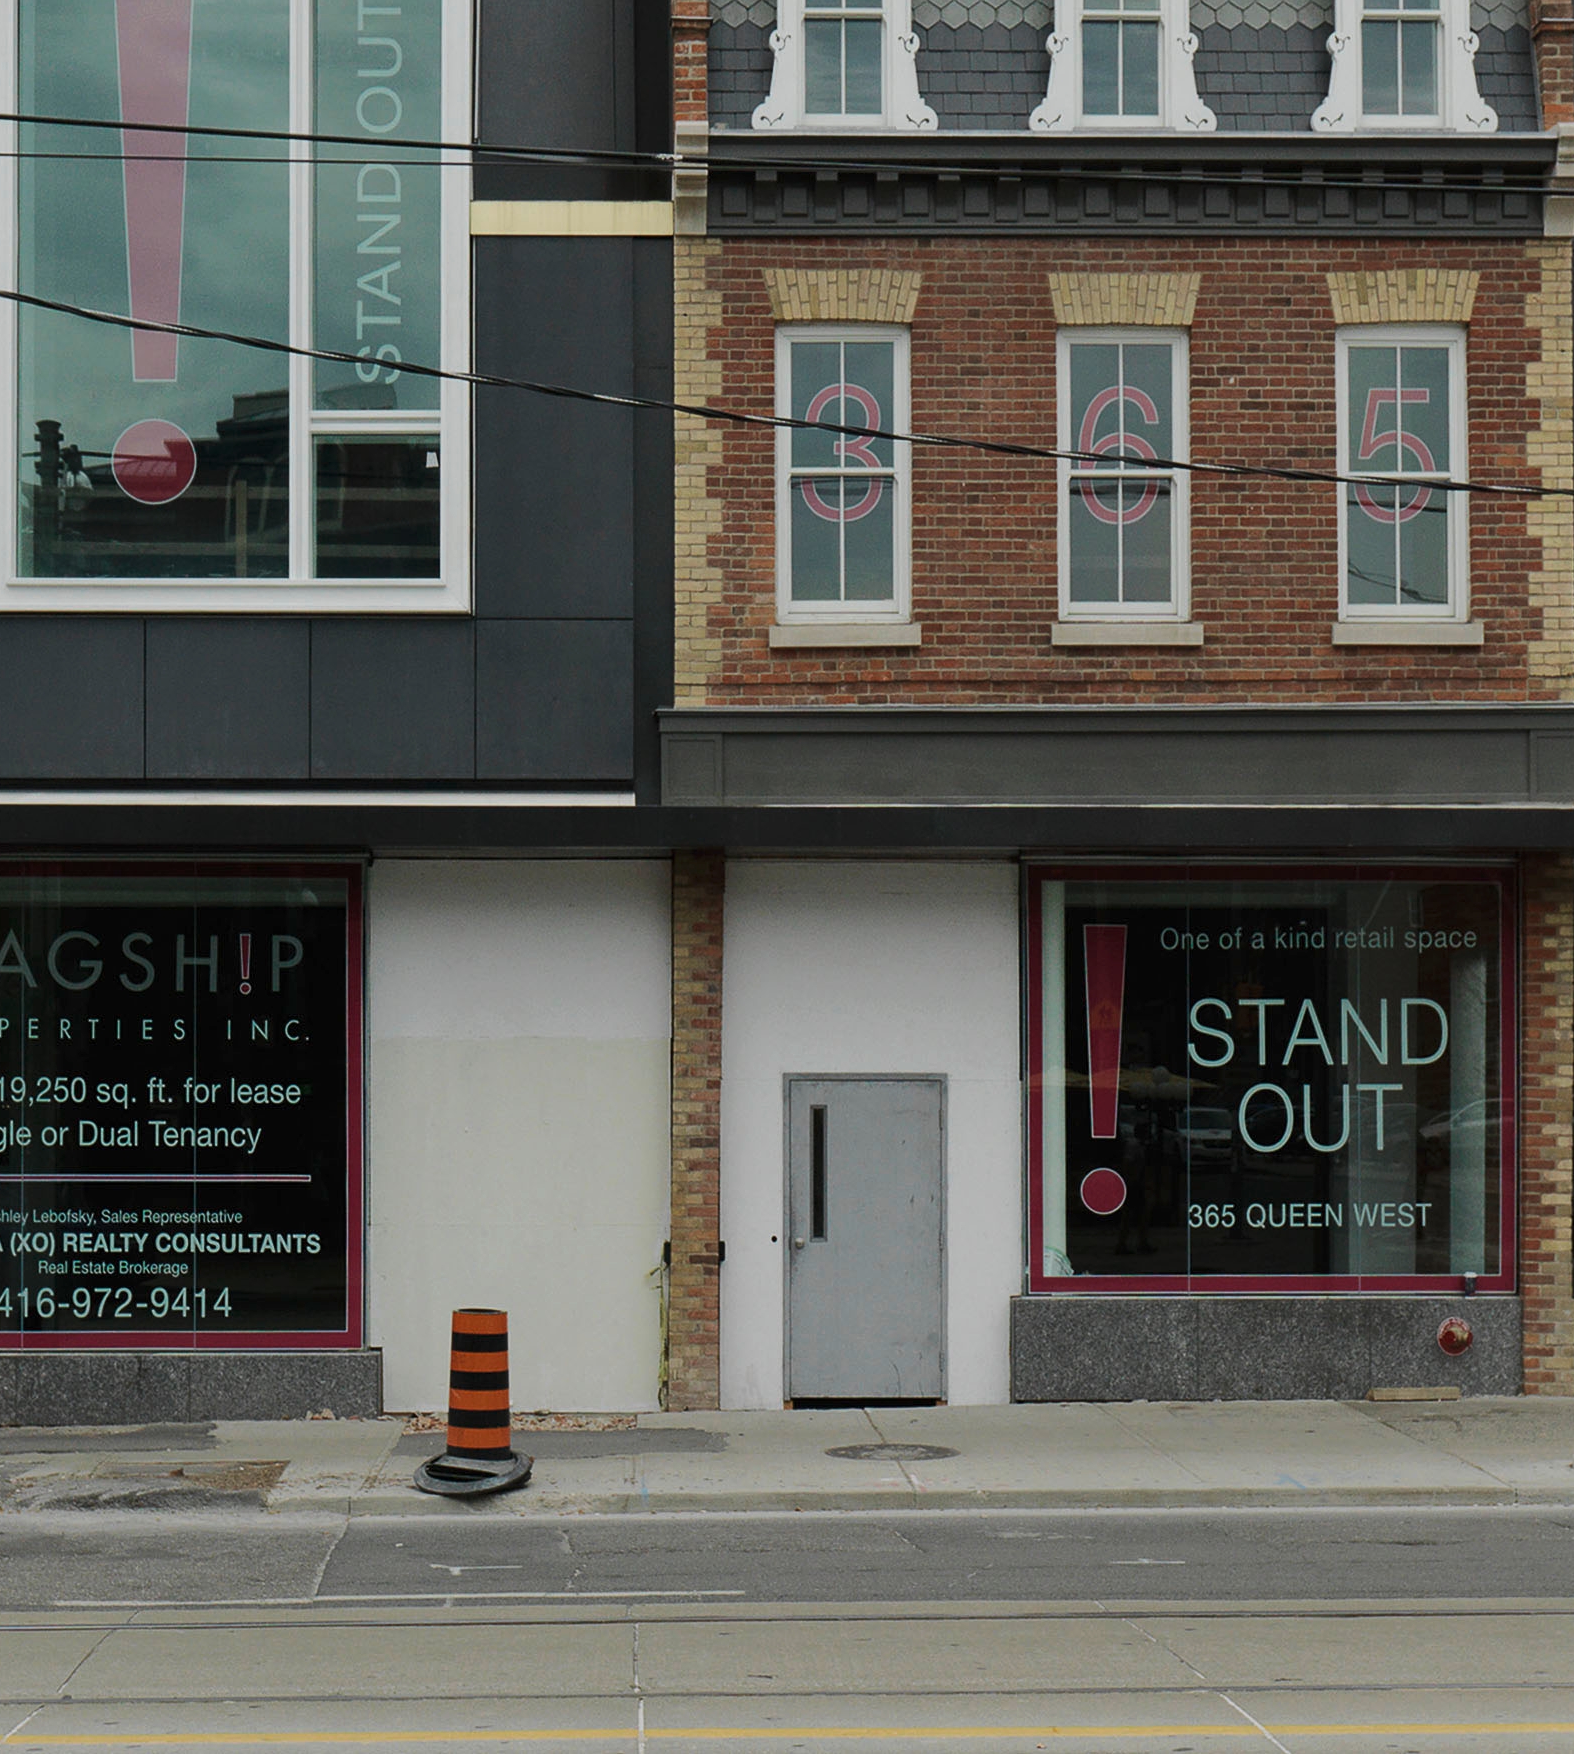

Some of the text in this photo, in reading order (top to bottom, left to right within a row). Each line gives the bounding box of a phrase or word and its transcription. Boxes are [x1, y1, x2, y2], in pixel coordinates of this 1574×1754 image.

[354, 163, 403, 385] STAND
[1160, 924, 1477, 953] One of a kind retail space
[227, 1019, 310, 1041] INC.
[1187, 997, 1449, 1068] STAND
[96, 1083, 137, 1110] sq.
[146, 1076, 173, 1104] ft.
[183, 1076, 220, 1104] for
[229, 1077, 302, 1104] lease
[1238, 1082, 1404, 1153] OUT
[41, 1126, 70, 1147] or
[79, 1120, 139, 1147] Dual
[147, 1120, 262, 1155] Tenancy
[33, 1208, 97, 1227] Lebofsky,
[101, 1208, 138, 1224] Sales
[142, 1209, 243, 1227] Representative
[1187, 1202, 1433, 1229] 365 QUEEN WEST
[10, 1231, 56, 1257] (XO)
[63, 1232, 149, 1253] REALTY
[156, 1233, 321, 1254] CONSULTANTS
[38, 1260, 189, 1278] Real Estate Brokerage
